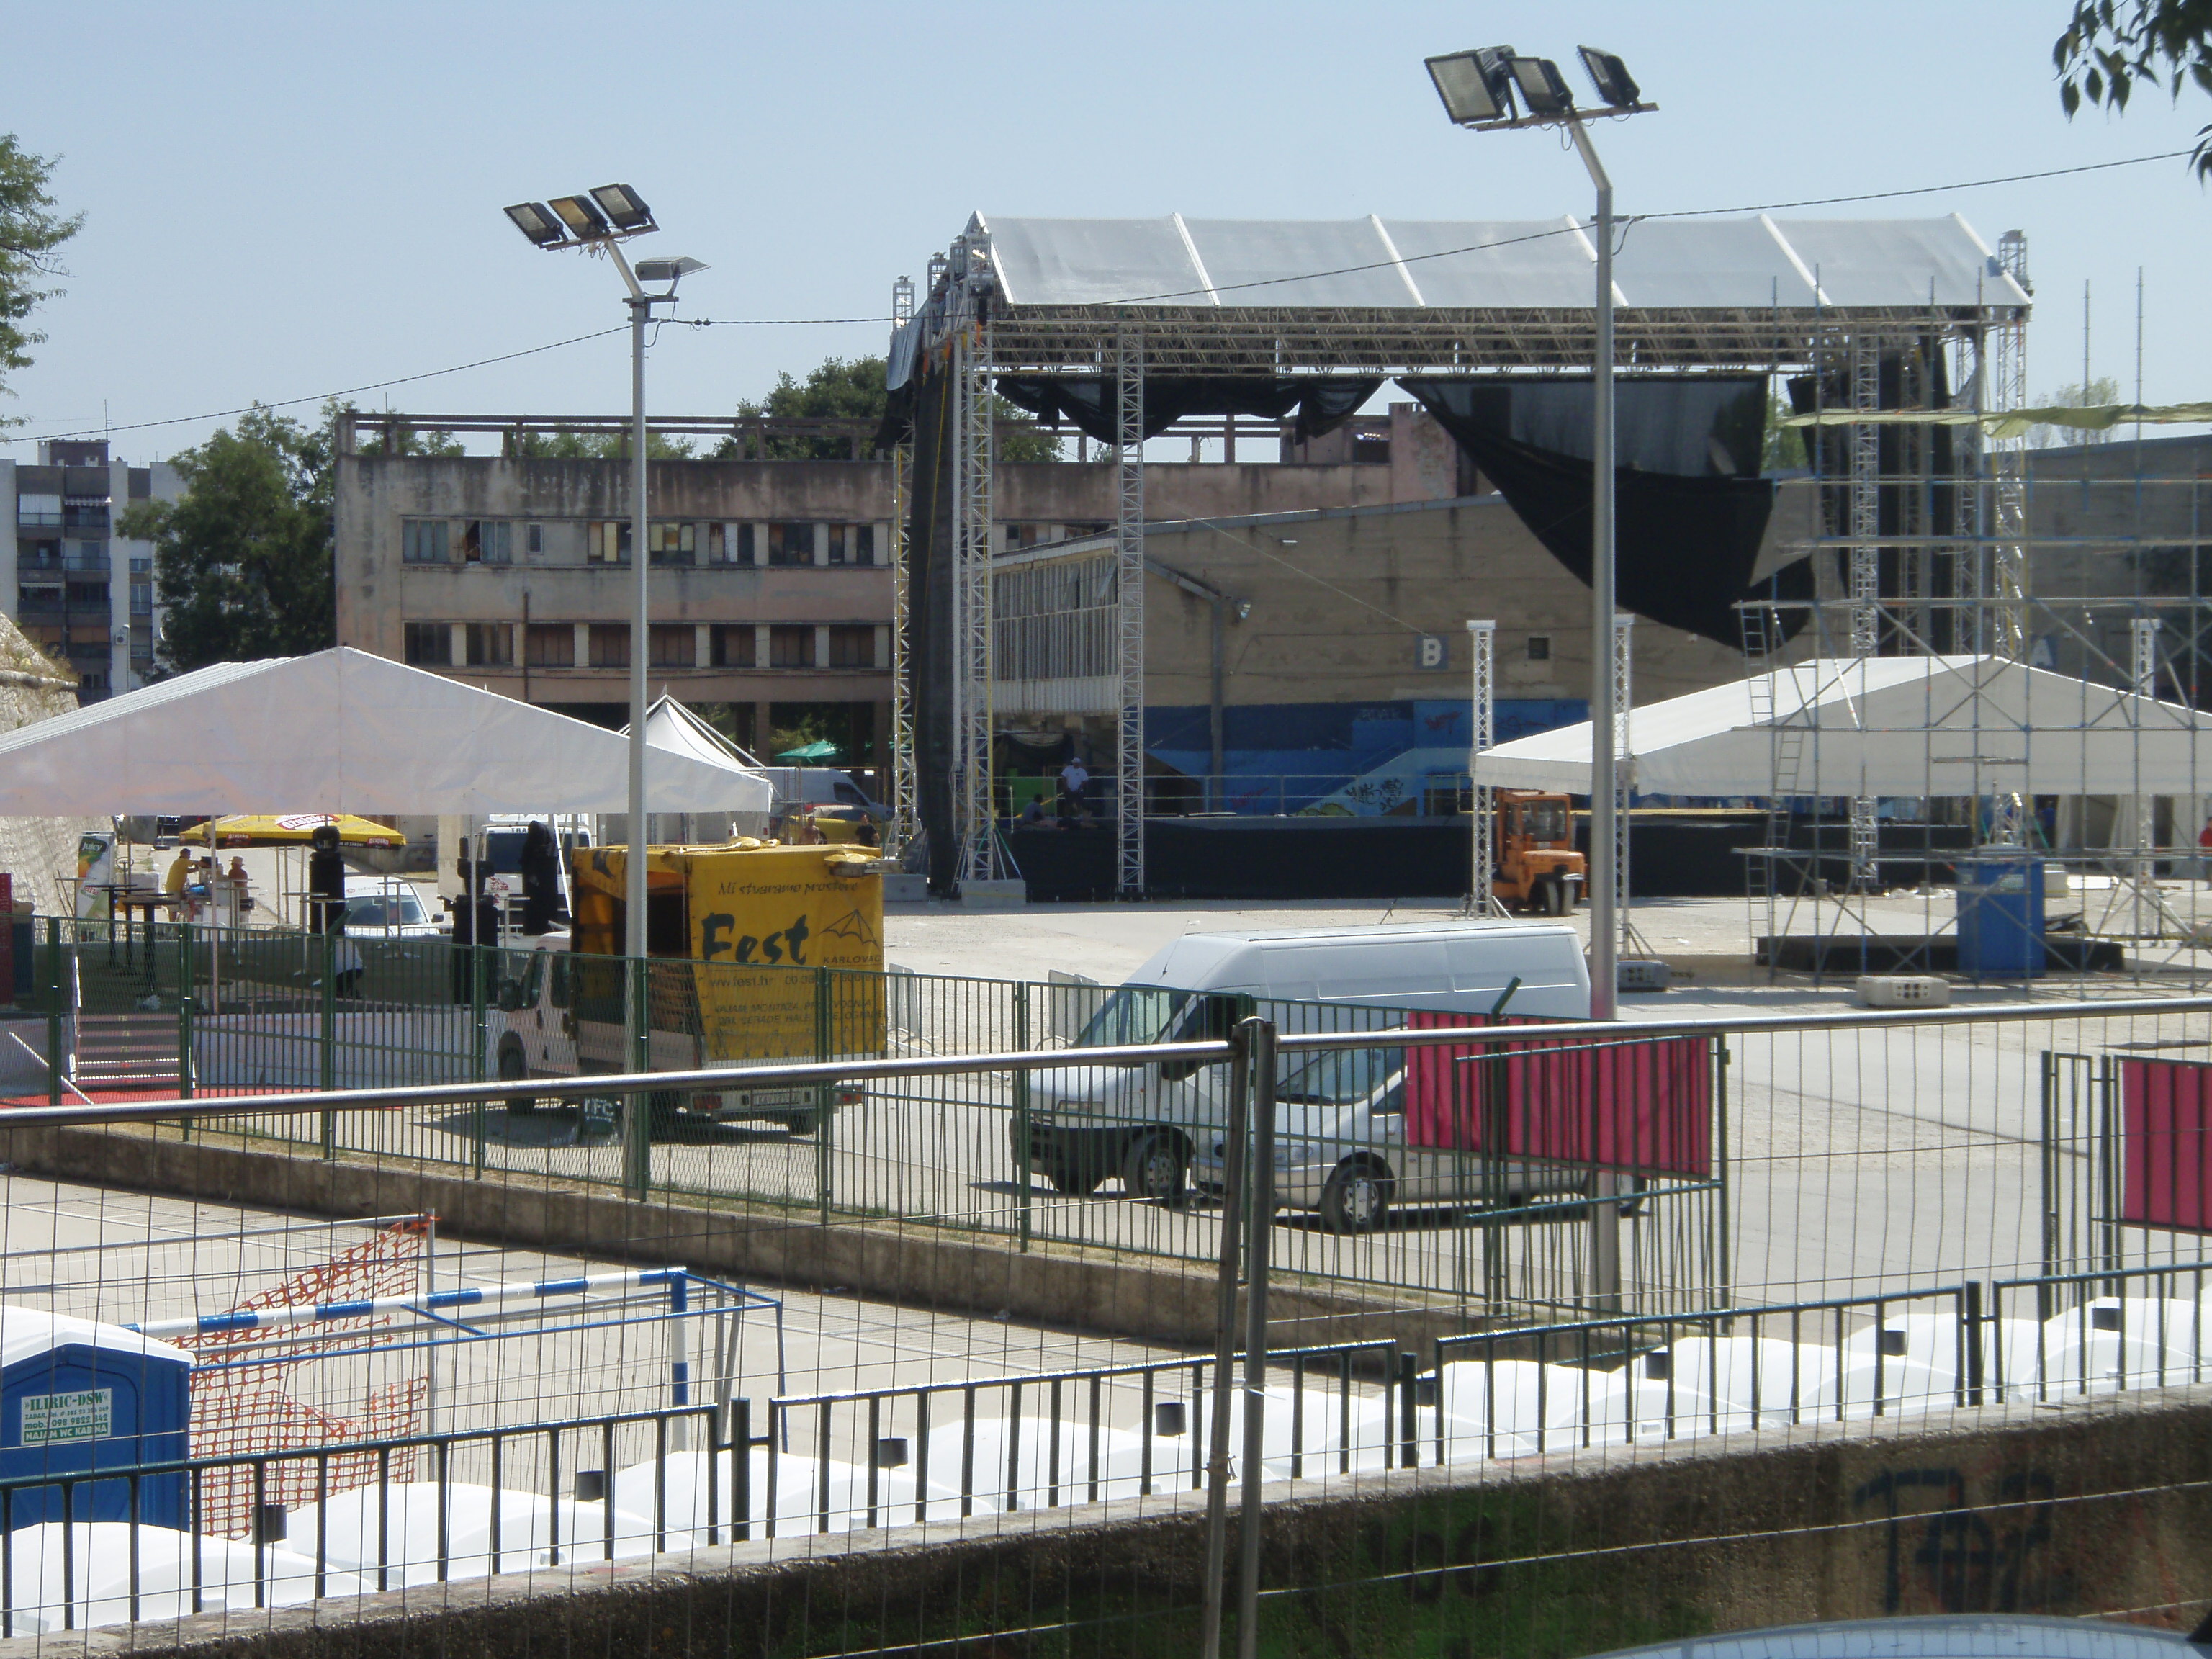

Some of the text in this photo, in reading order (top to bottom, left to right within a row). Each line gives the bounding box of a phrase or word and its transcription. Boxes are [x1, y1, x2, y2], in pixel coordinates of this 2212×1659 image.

[1423, 638, 1442, 667] B
[701, 912, 810, 966] Fest
[823, 954, 882, 965] KARLOVAC
[51, 1418, 68, 1427] 098
[71, 1415, 91, 1425] 9822
[25, 1424, 107, 1441] NAJAM WC KABNA
